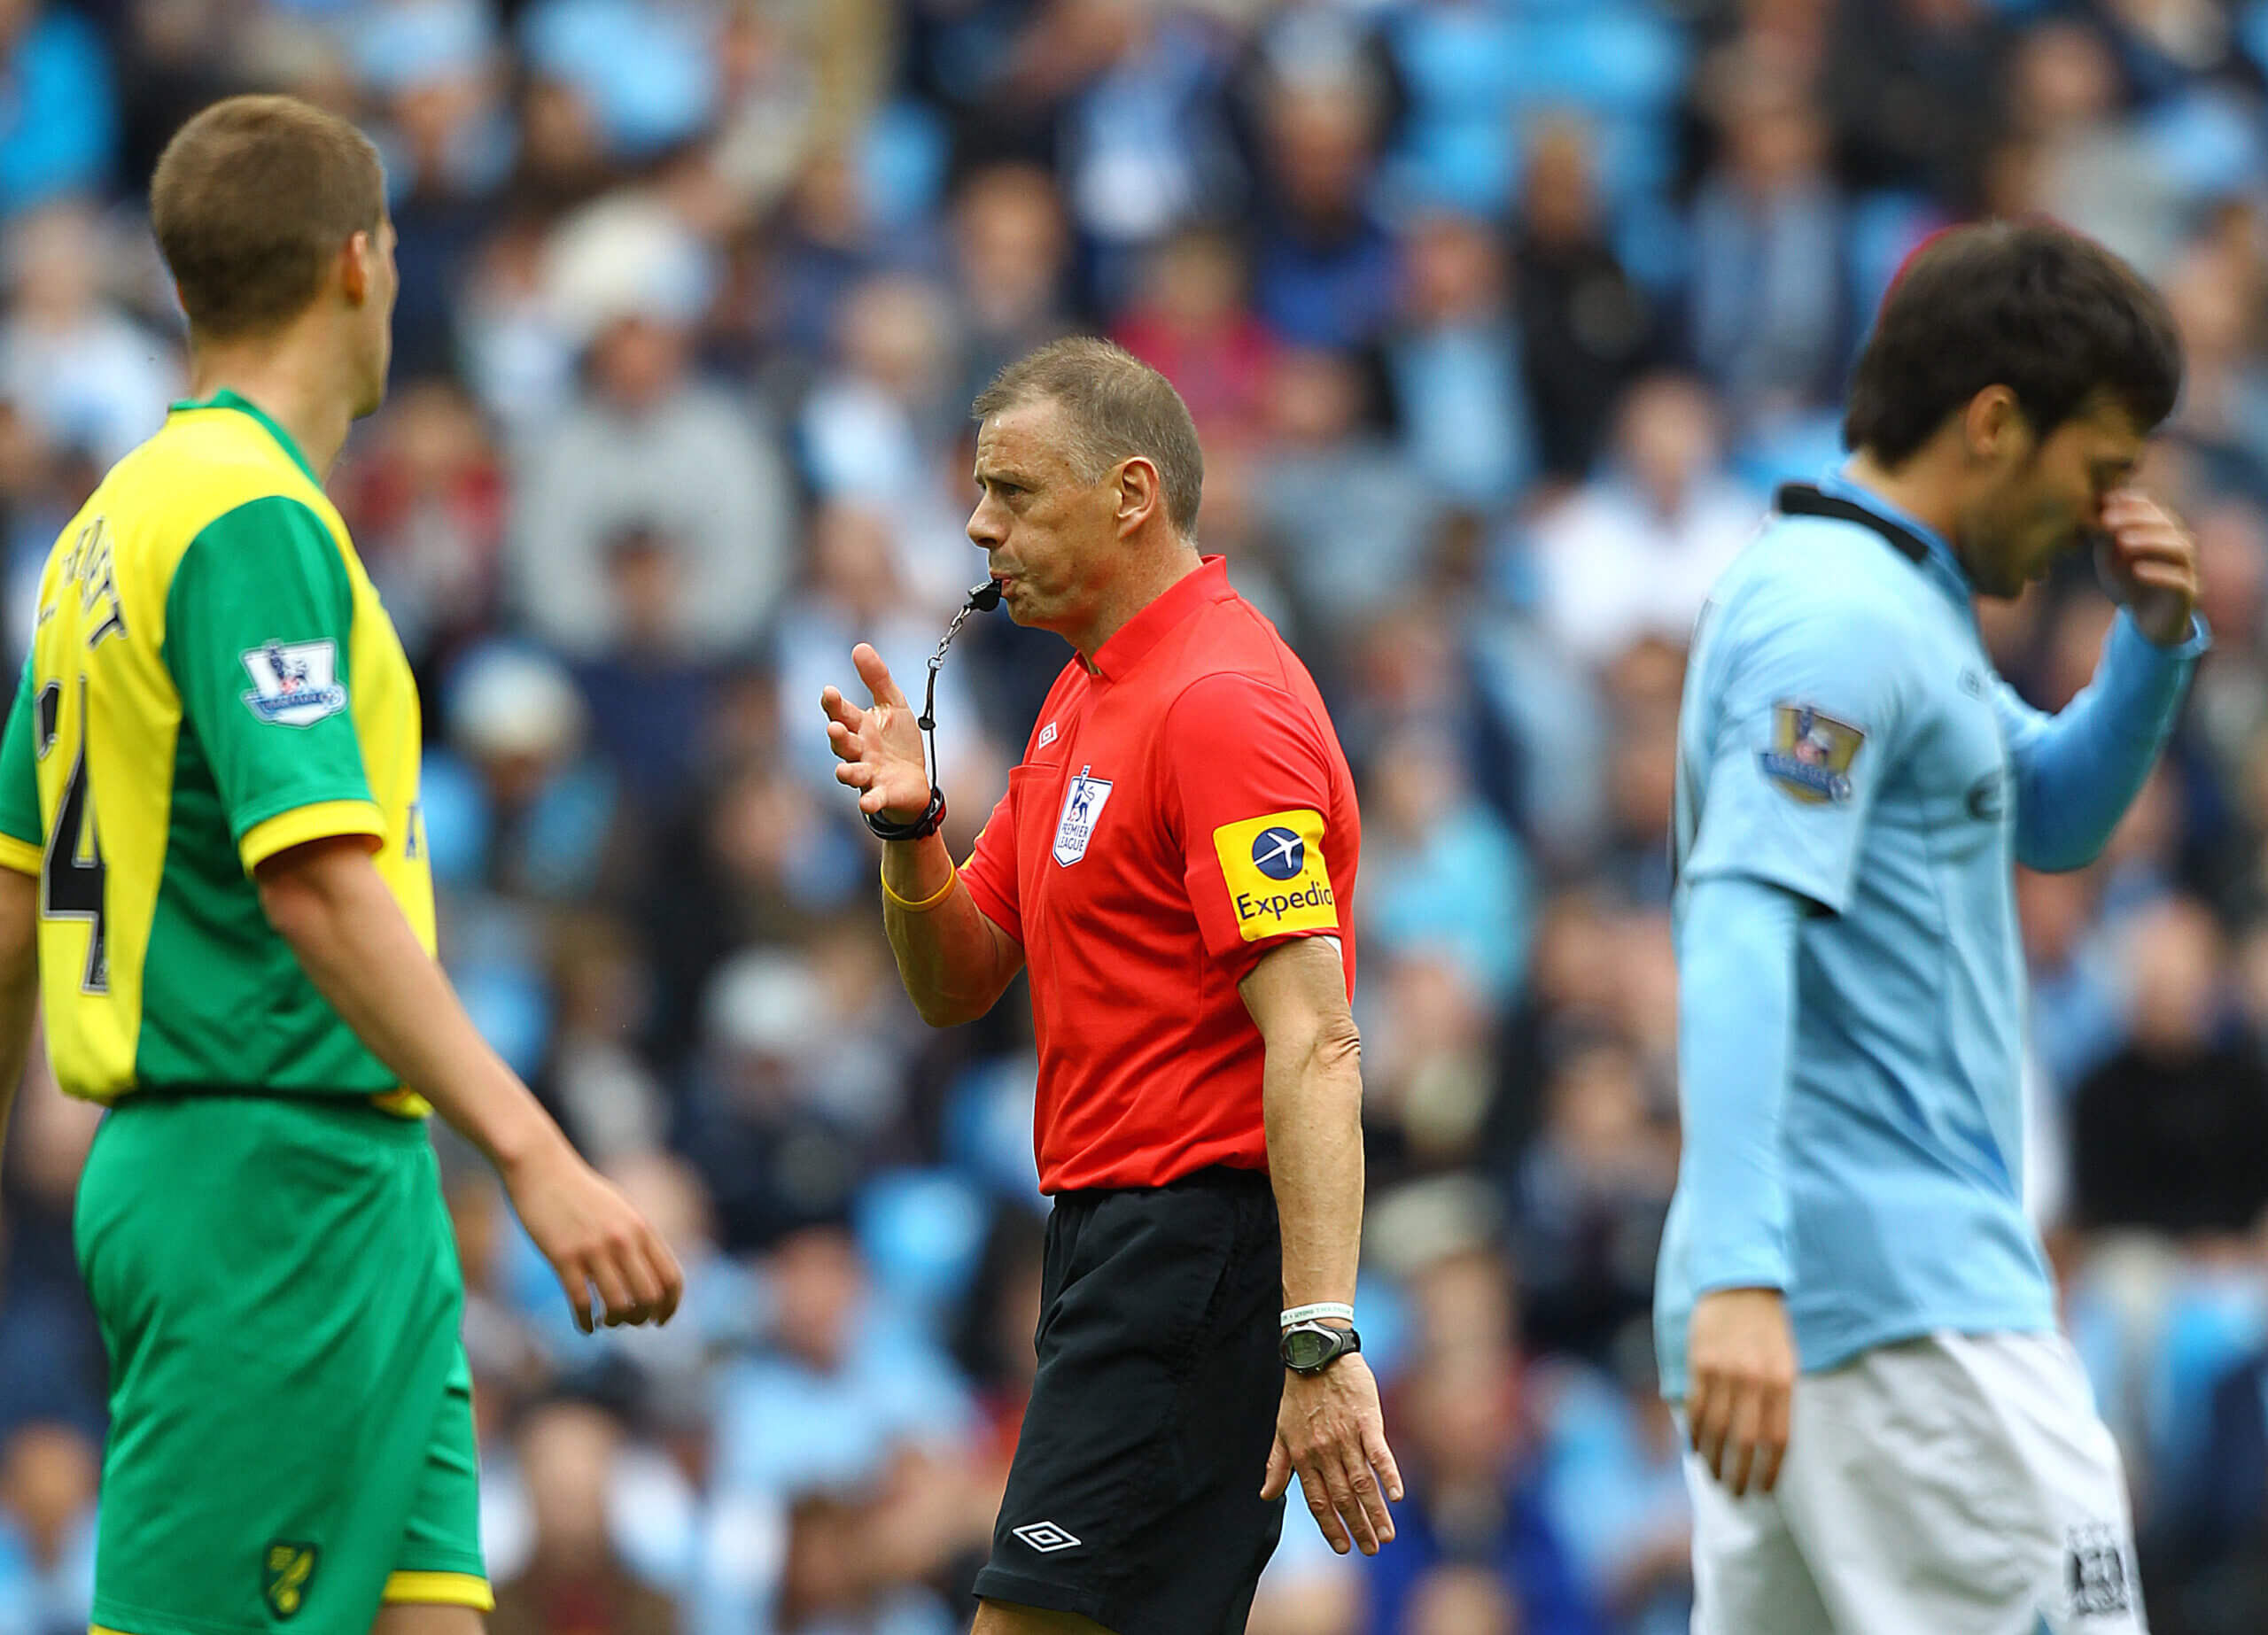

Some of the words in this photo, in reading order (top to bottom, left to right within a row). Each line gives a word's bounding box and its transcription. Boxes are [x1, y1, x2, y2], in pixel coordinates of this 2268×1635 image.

[1061, 822, 1089, 838] PREMIER
[1056, 836, 1085, 852] LEAGUE
[1236, 879, 1333, 921] Expedia
